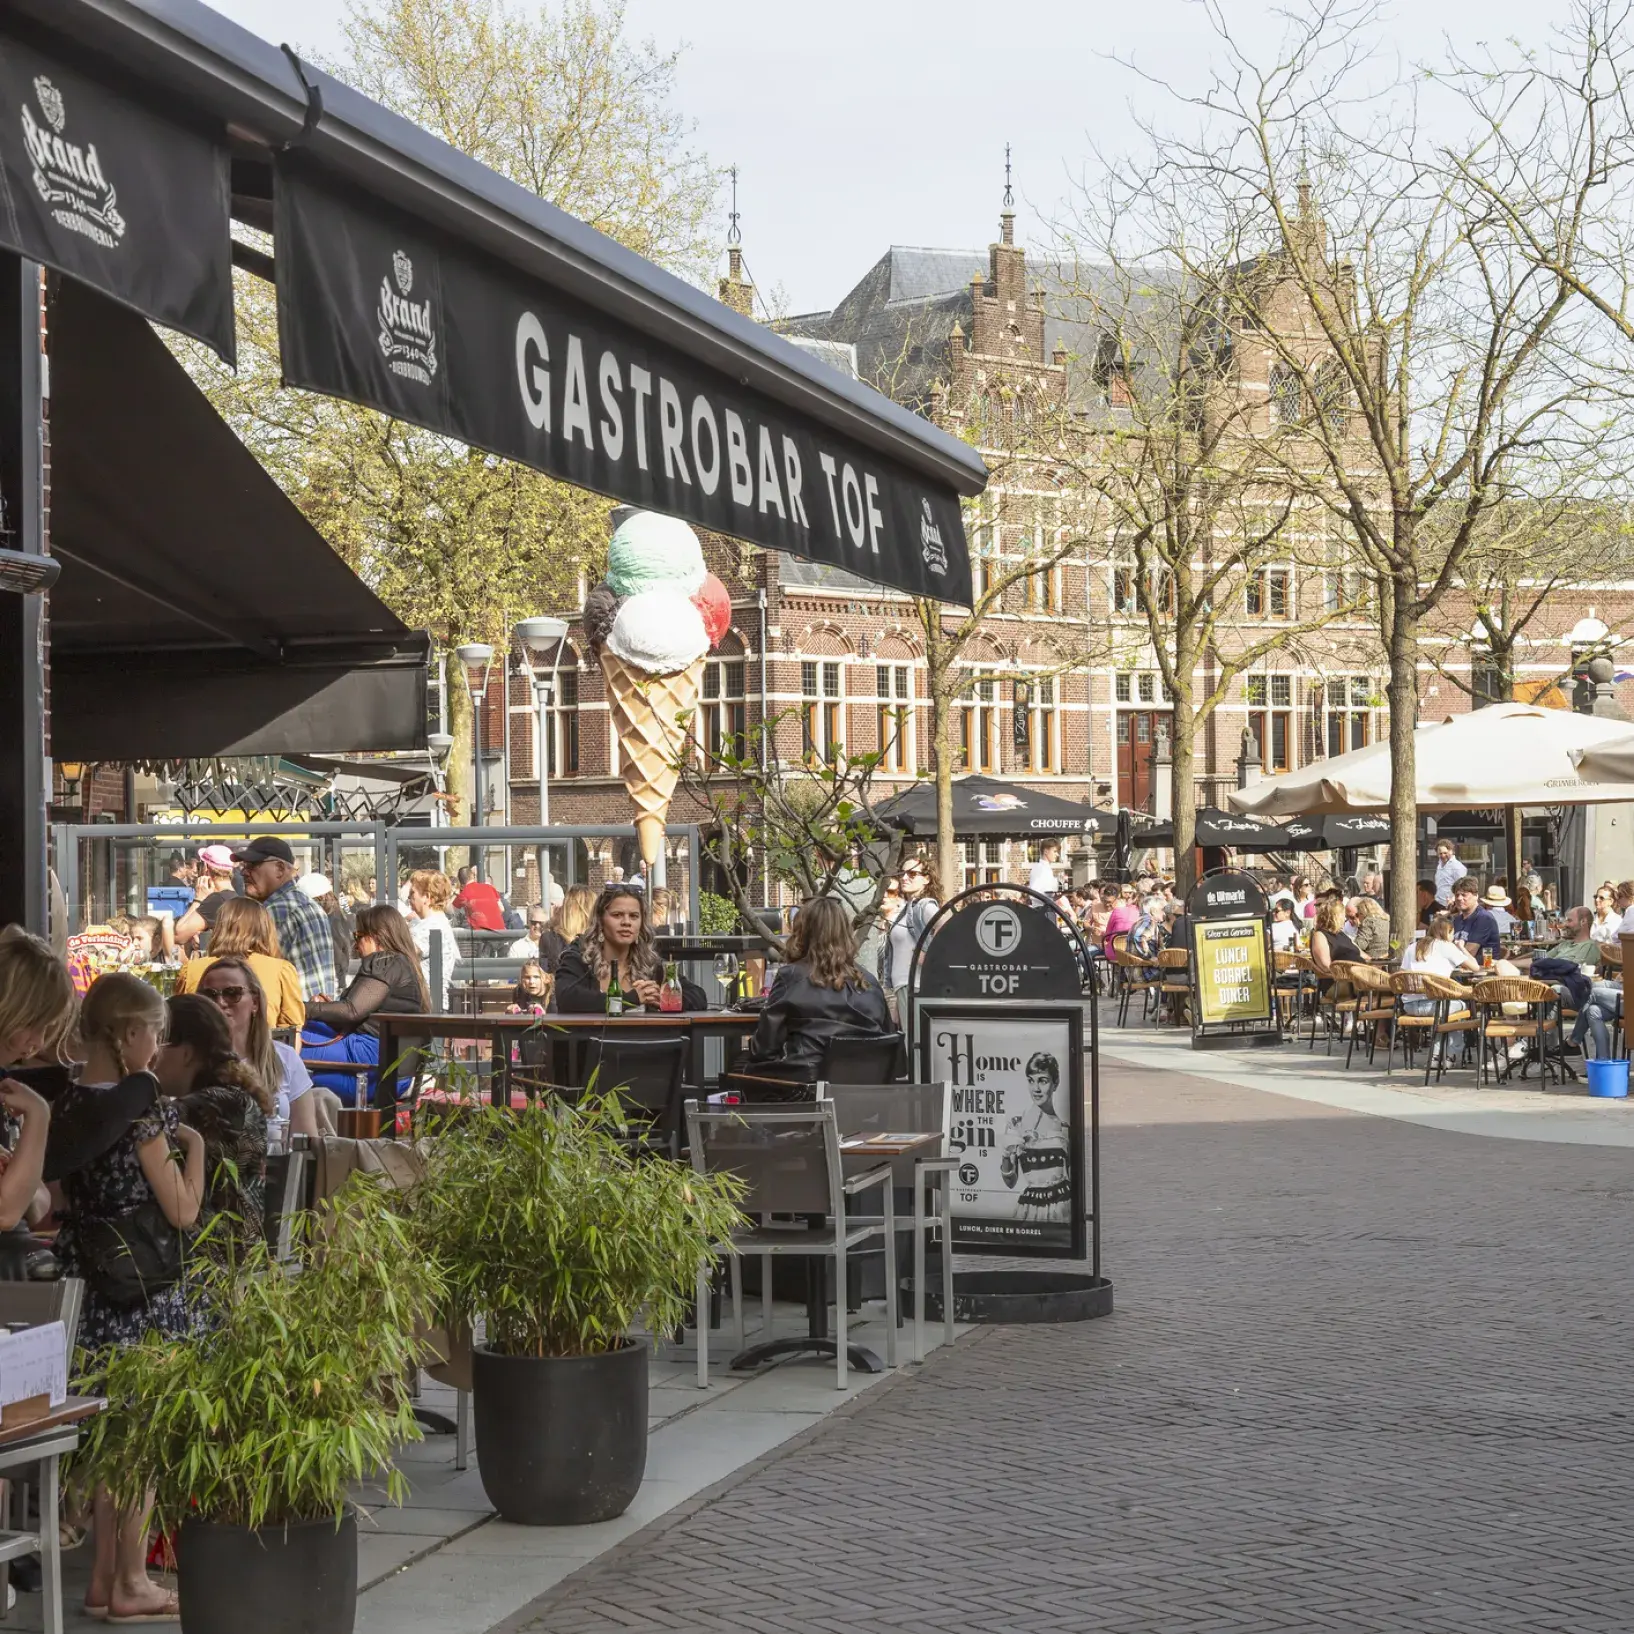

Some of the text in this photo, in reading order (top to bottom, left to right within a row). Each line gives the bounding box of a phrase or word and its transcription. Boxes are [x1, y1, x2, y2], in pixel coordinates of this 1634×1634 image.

[21, 103, 109, 192] Brand
[380, 275, 431, 339] Brand
[516, 311, 883, 554] GASTROBAR TOF
[1030, 818, 1081, 829] CHOUFFE
[1207, 891, 1216, 902] de
[1215, 946, 1248, 965] LUNCH
[1214, 965, 1253, 984] BORREL
[979, 975, 1019, 994] TOF
[1219, 986, 1250, 1004] DINER
[937, 1032, 1021, 1086] Home
[977, 1073, 985, 1081] IS
[952, 1089, 1005, 1114] WHERE
[977, 1116, 993, 1125] THE
[950, 1119, 995, 1153] gin
[979, 1149, 987, 1157] IS
[960, 1193, 978, 1203] TOF
[959, 1225, 983, 1233] LUNCH,
[985, 1226, 1004, 1234] DINER
